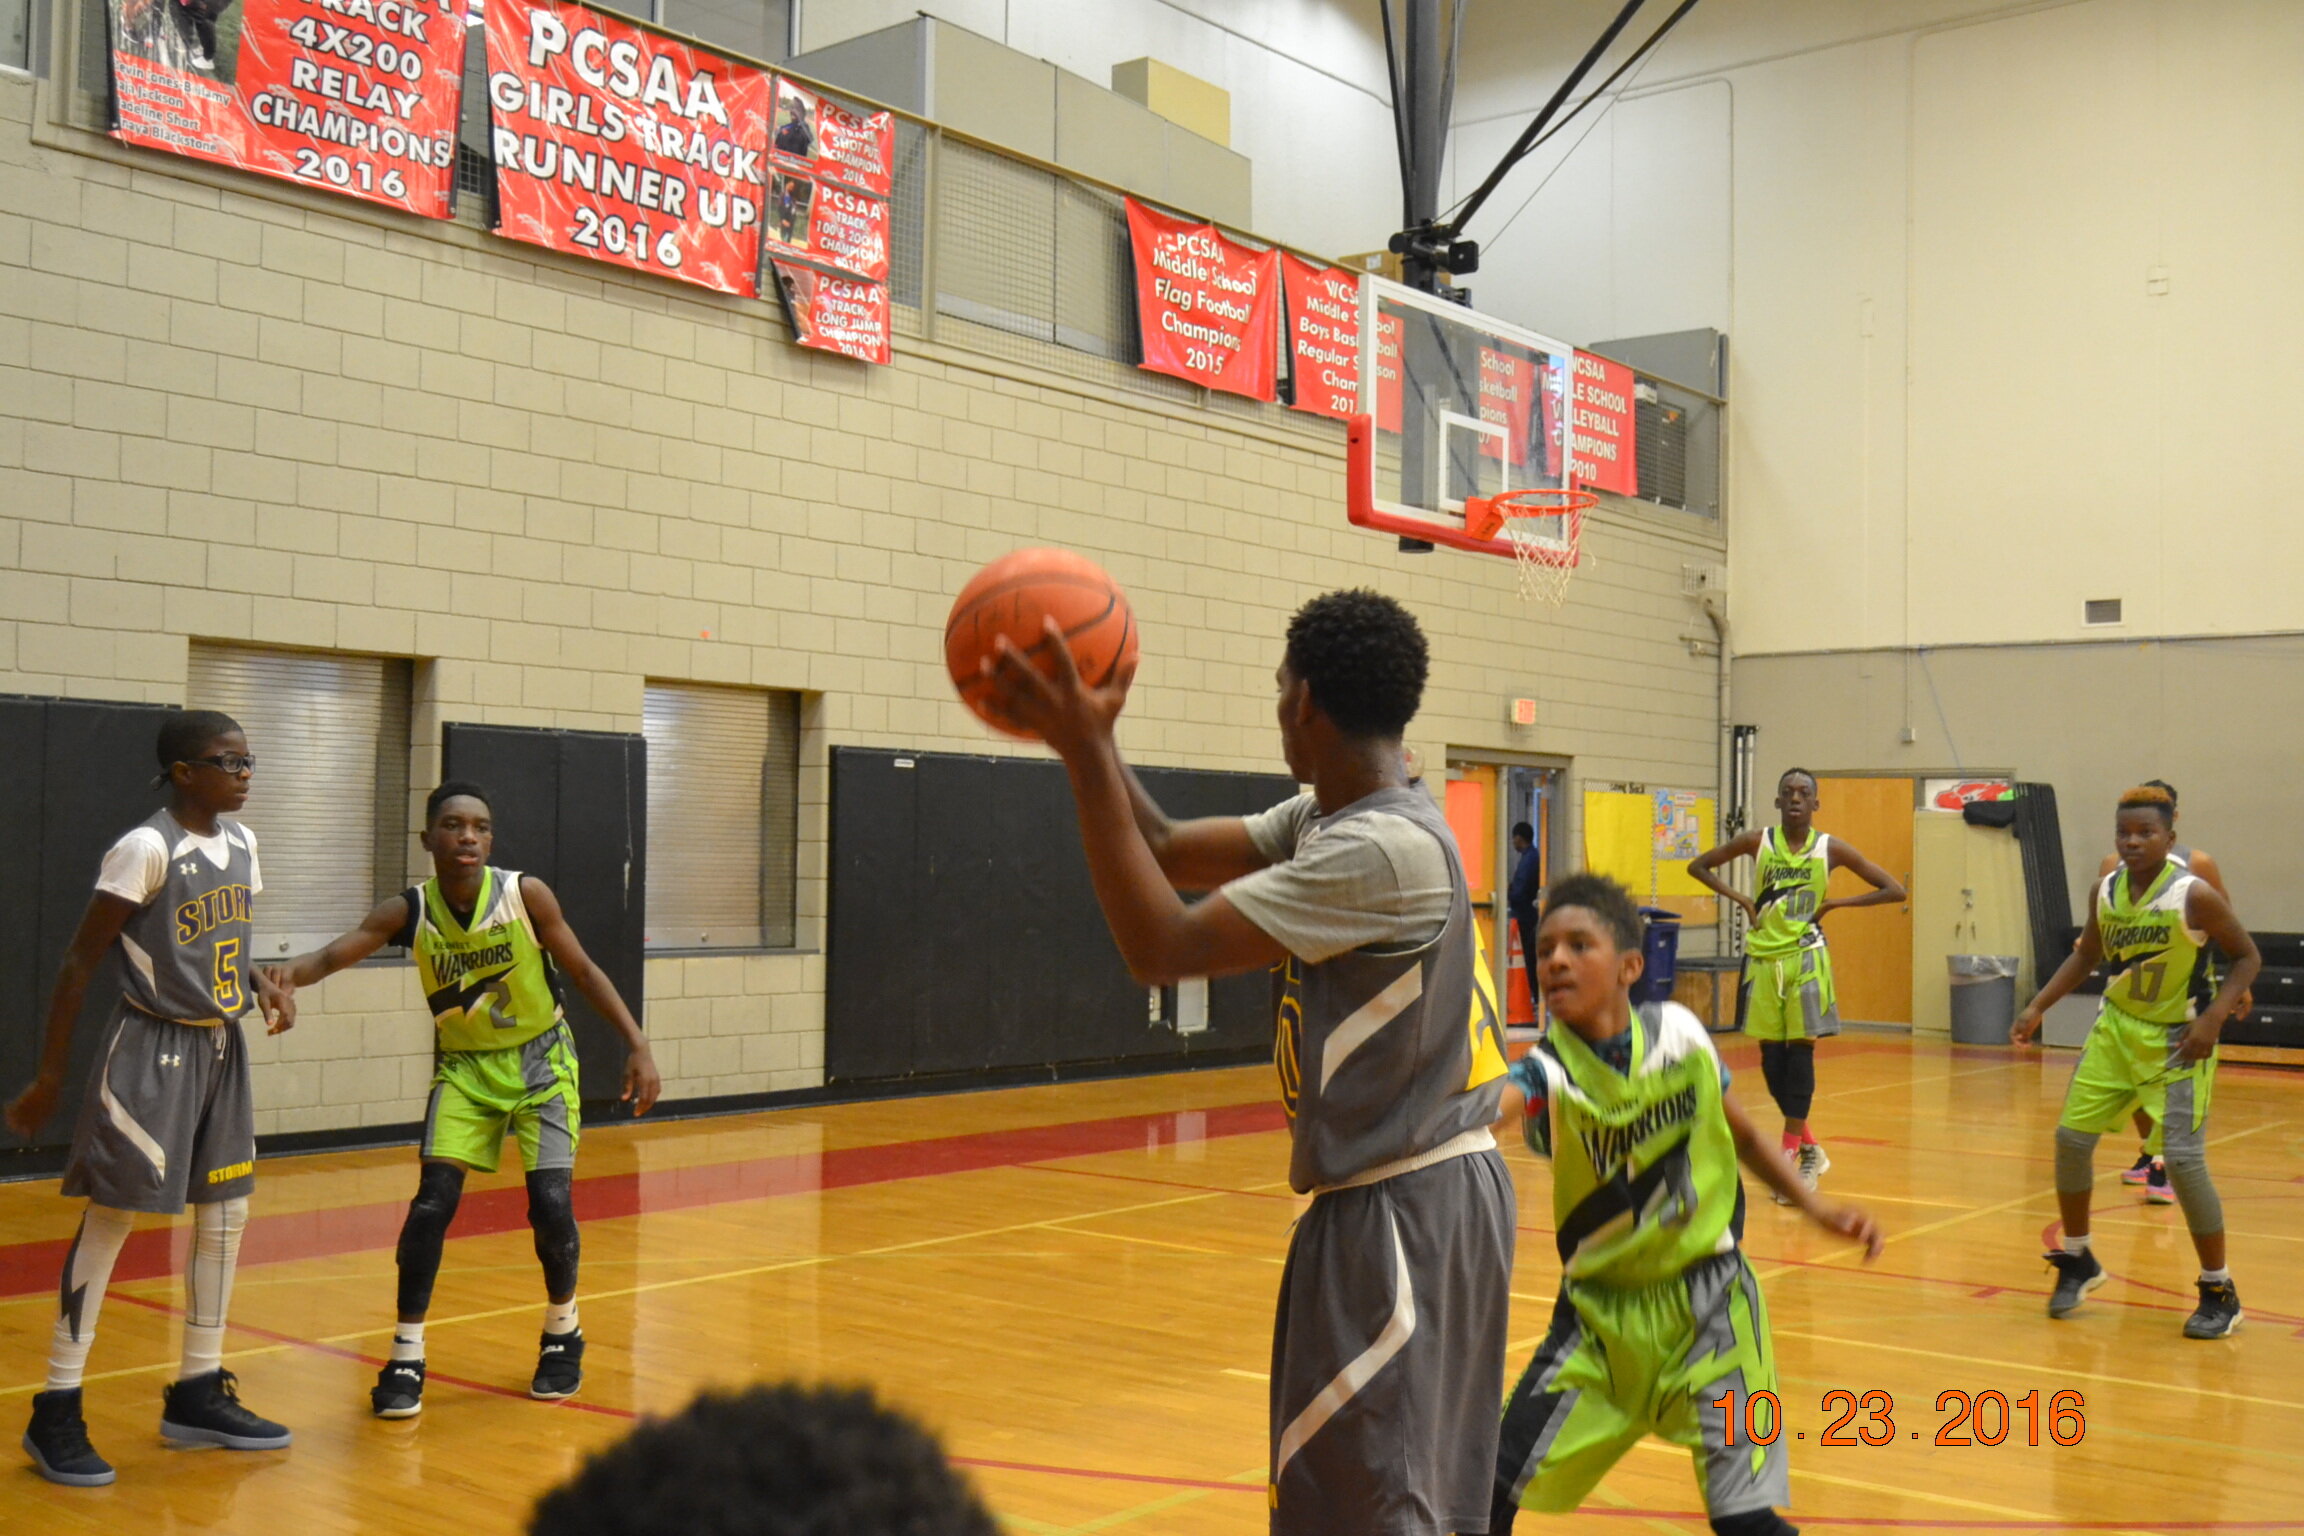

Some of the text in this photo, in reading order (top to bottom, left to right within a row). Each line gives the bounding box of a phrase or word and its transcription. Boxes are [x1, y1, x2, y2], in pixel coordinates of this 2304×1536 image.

[304, 0, 430, 44] ACK
[289, 16, 423, 81] 4X200
[115, 60, 145, 80] evin
[527, 9, 729, 126] PCSAA
[138, 85, 184, 108] Jackson
[291, 57, 423, 120] RELAY
[120, 98, 200, 133] adeline Short
[251, 91, 453, 169] CHAMPIONS
[488, 70, 765, 187] GIRLS TRACK
[822, 103, 891, 132] PCSAA
[120, 118, 217, 154] naya Blackstone
[832, 135, 881, 161] SHOT PUT
[295, 148, 407, 199] 2016
[828, 148, 882, 175] CHAMPION
[842, 167, 866, 186] 2016
[493, 126, 756, 234] RUNNER UP
[822, 187, 881, 221] PCSAA
[815, 219, 837, 237] 100
[838, 226, 846, 240] &
[835, 210, 869, 231] TRACK
[572, 205, 683, 269] 2016
[1176, 232, 1226, 267] PCSAA
[1152, 247, 1257, 298] Middle School
[818, 275, 881, 305] PCSAA
[1154, 277, 1253, 325] Flag Football
[815, 310, 882, 332] LONG JUMP
[831, 298, 866, 317] TRACK
[1306, 296, 1350, 322] Middle
[1160, 309, 1242, 353] Champions
[1299, 315, 1330, 341] Boys
[1185, 347, 1225, 376] 2015
[1297, 338, 1350, 368] Regular
[1480, 350, 1515, 376] School
[1330, 393, 1359, 415] 201
[1478, 375, 1518, 403] sketball
[1586, 385, 1628, 414] SCHOOL
[1571, 459, 1598, 481] 2010
[1761, 864, 1813, 888] WARRIORS
[2101, 924, 2171, 950] WARRIORS
[213, 937, 244, 1013] 5
[430, 942, 514, 988] WARRIORS
[2127, 960, 2169, 1003] 17
[483, 981, 518, 1030] 2
[207, 1159, 253, 1185] STORM
